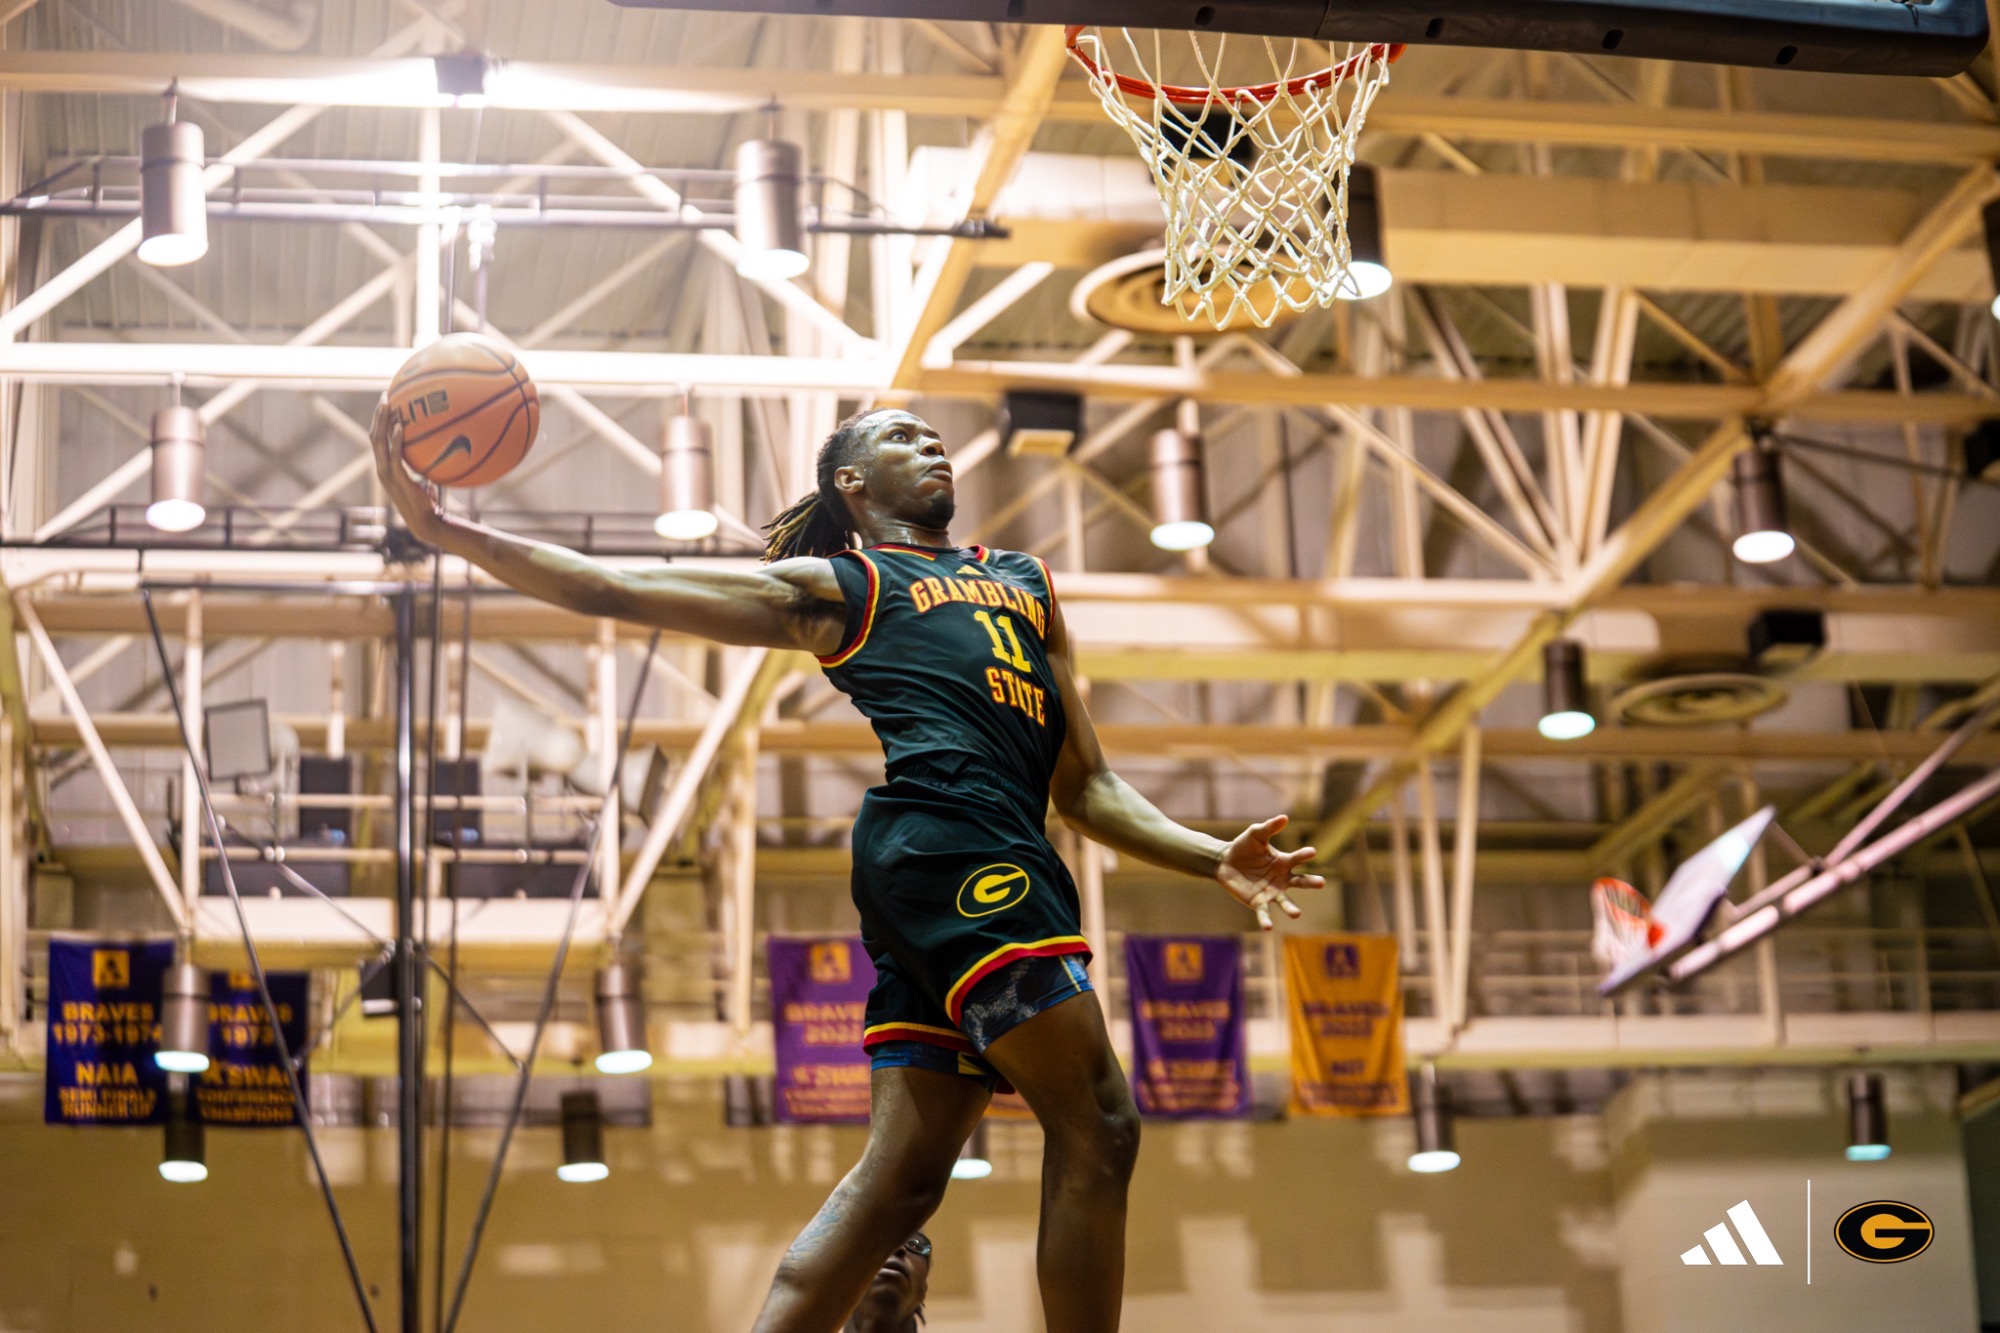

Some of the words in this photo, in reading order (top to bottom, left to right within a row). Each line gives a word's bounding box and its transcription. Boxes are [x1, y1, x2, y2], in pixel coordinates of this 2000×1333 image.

[909, 576, 1045, 640] GRAMBLING
[973, 610, 1031, 673] 11
[984, 666, 1045, 727] STATE
[62, 1001, 154, 1022] BRAVES
[784, 1002, 867, 1024] BRAVE
[75, 1061, 138, 1085] NAIA
